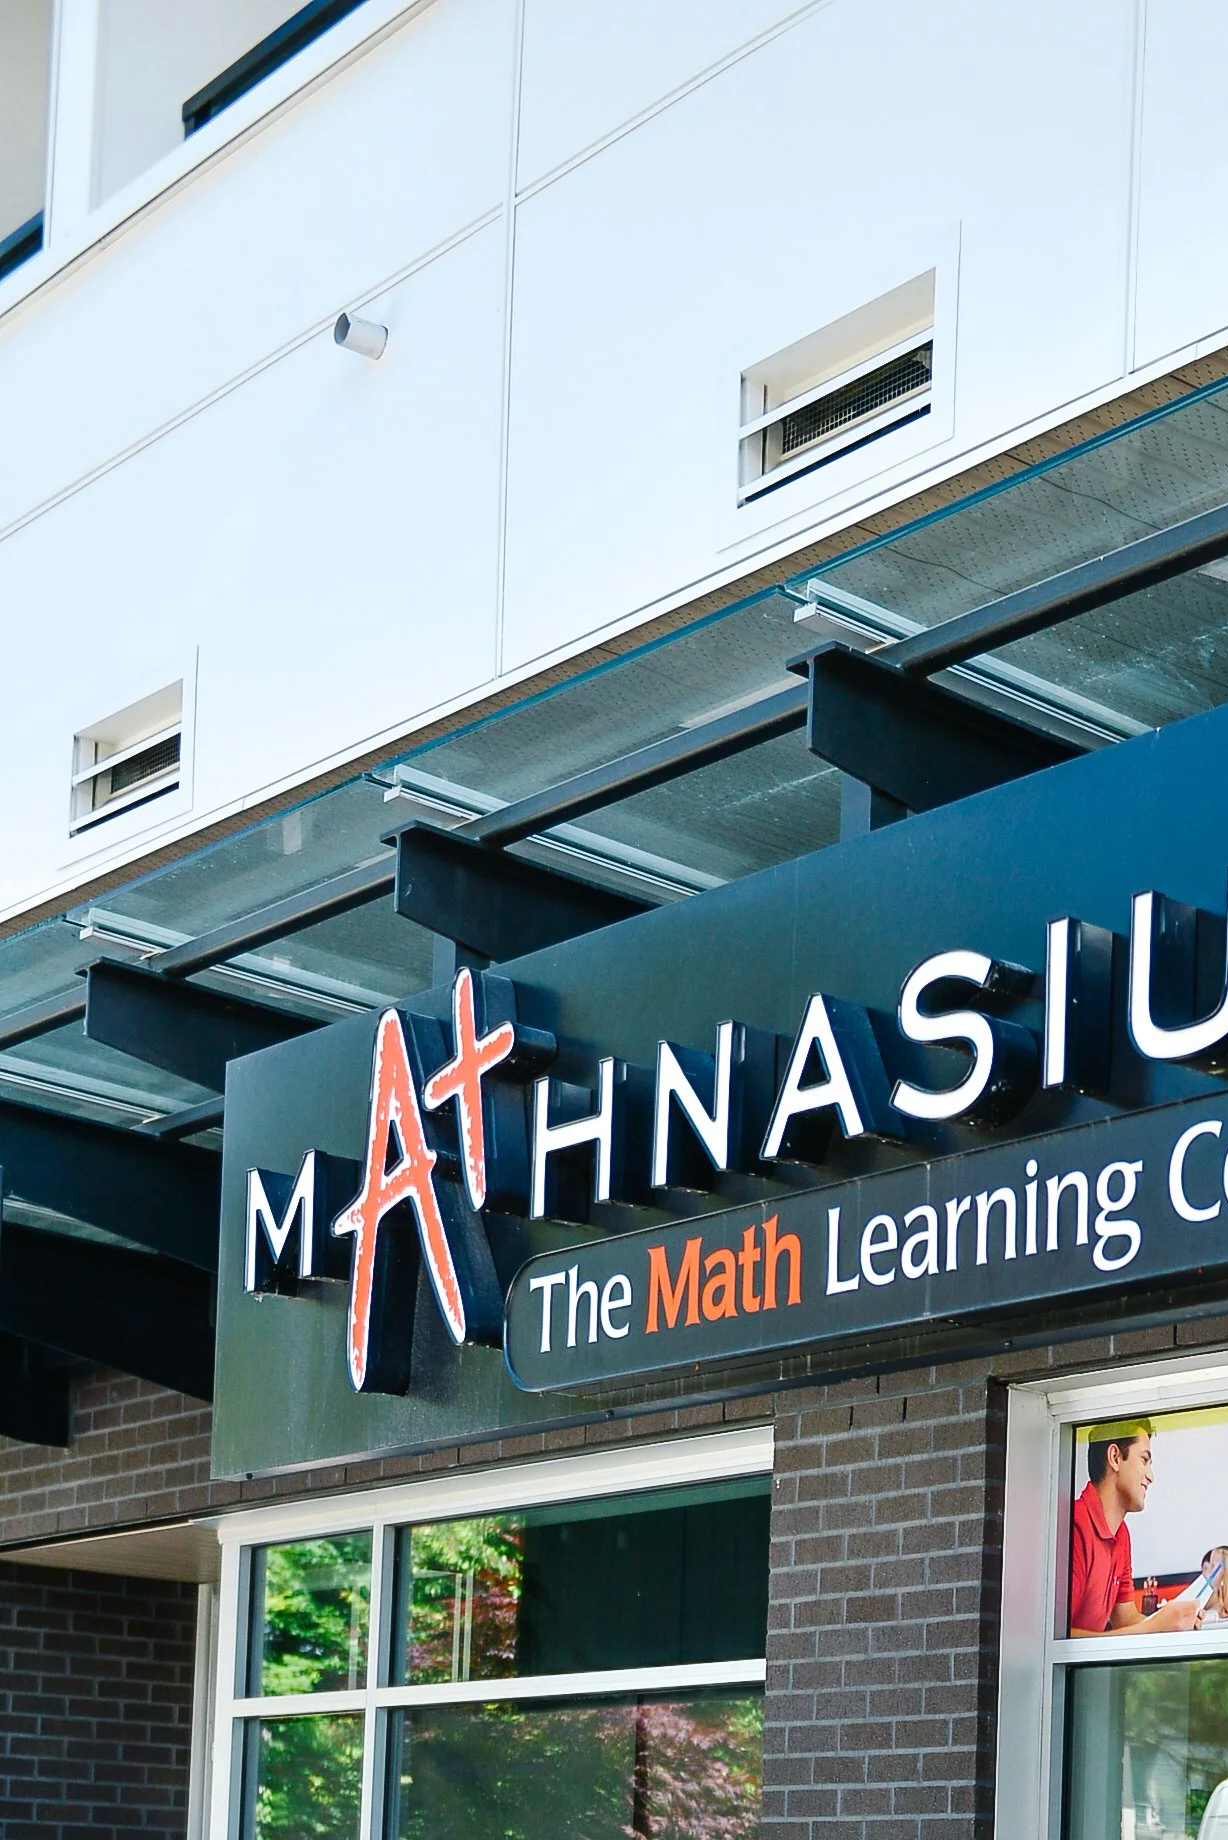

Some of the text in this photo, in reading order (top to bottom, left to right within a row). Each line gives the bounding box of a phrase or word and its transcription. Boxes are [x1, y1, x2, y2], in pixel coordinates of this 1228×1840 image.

[529, 1264, 633, 1353] The
[645, 1215, 803, 1335] Math
[824, 1159, 1144, 1296] Learning
